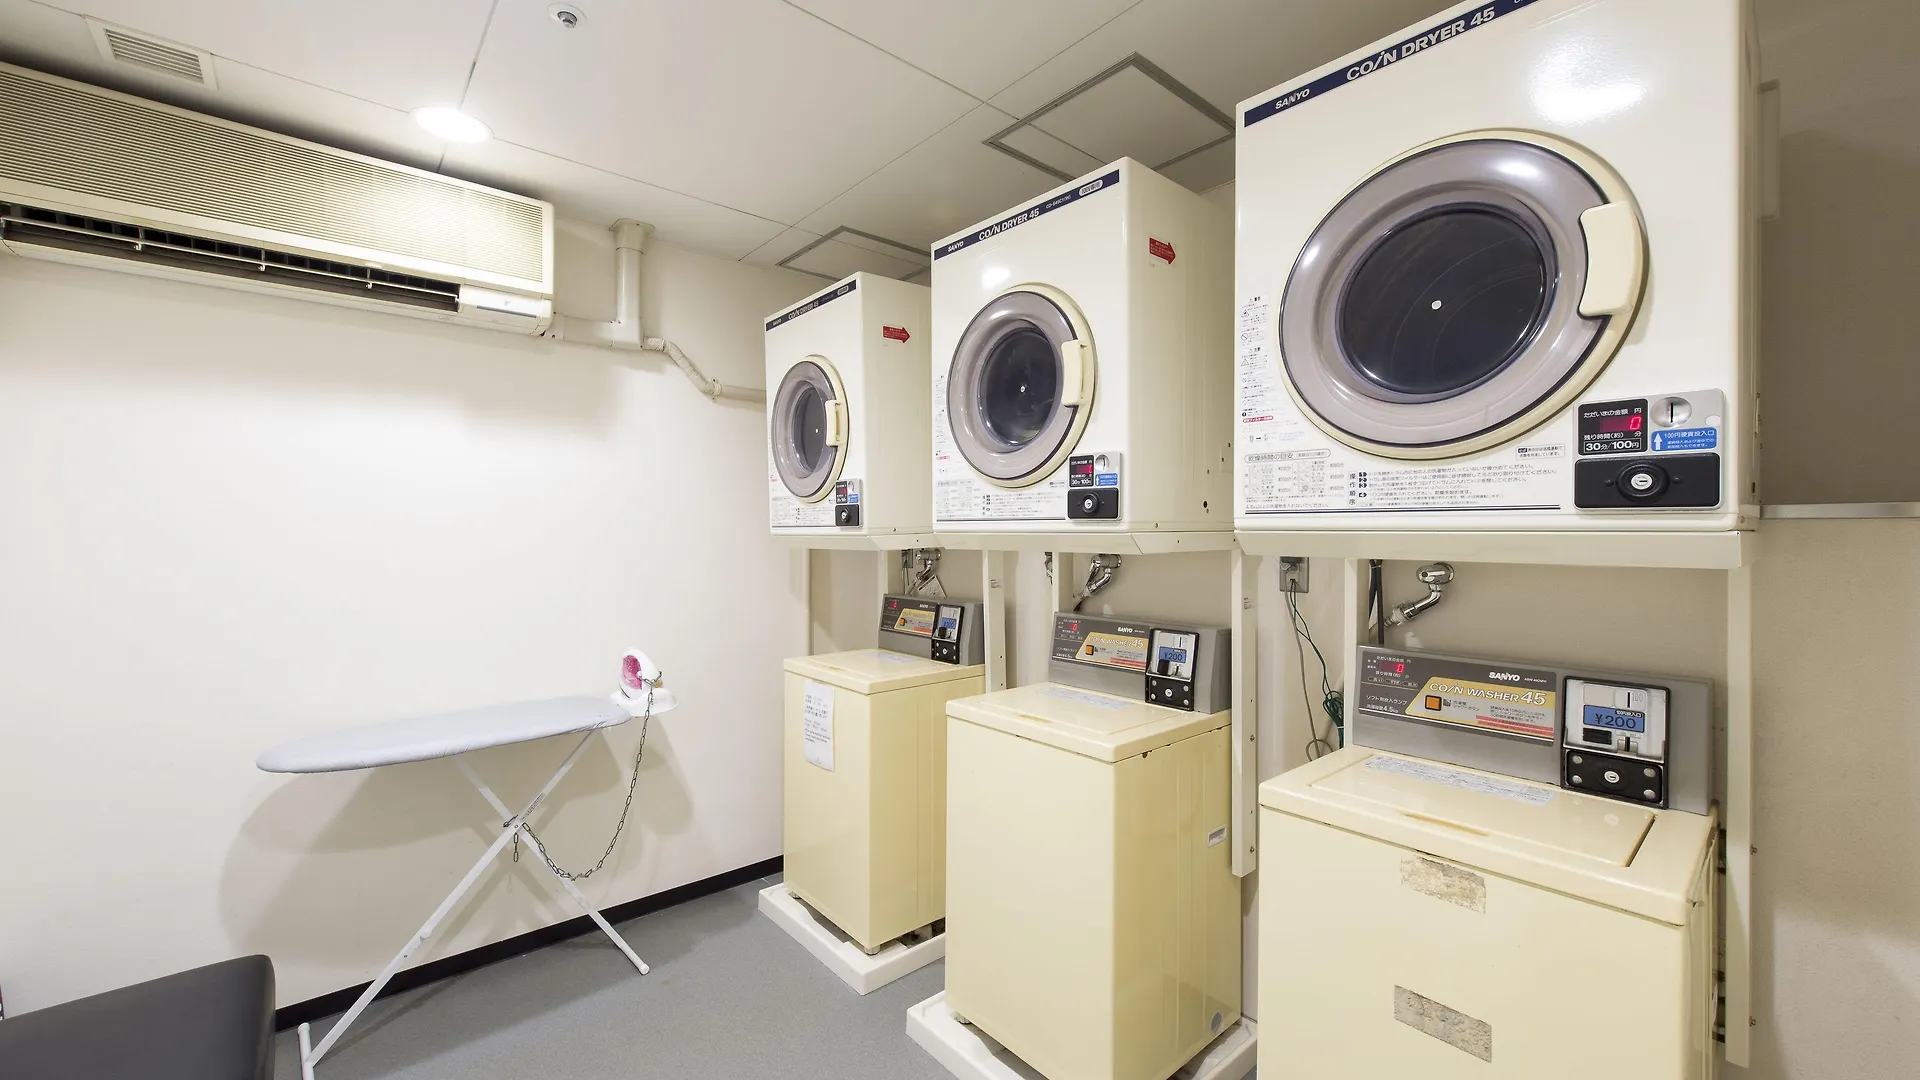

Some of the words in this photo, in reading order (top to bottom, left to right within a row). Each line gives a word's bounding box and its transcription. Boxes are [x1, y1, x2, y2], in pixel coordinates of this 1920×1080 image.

[1401, 15, 1465, 57] DRYER
[1470, 6, 1495, 26] 45
[1275, 88, 1310, 109] SANYO
[1001, 212, 1029, 231] DRYER
[1028, 207, 1040, 219] 45
[947, 241, 964, 252] SANYO
[1583, 408, 1629, 418] ただいまの金額
[1629, 416, 1642, 430] 0
[1583, 432, 1624, 441] 残り時間(約)
[1585, 440, 1640, 451] 30分/100円
[1117, 626, 1133, 634] SANYO
[1131, 638, 1144, 649] 45
[1396, 663, 1405, 673] 0
[1488, 671, 1521, 682] SANYO
[1467, 687, 1519, 702] WASHER
[1520, 690, 1547, 706] 45
[1595, 713, 1636, 729] ¥200
